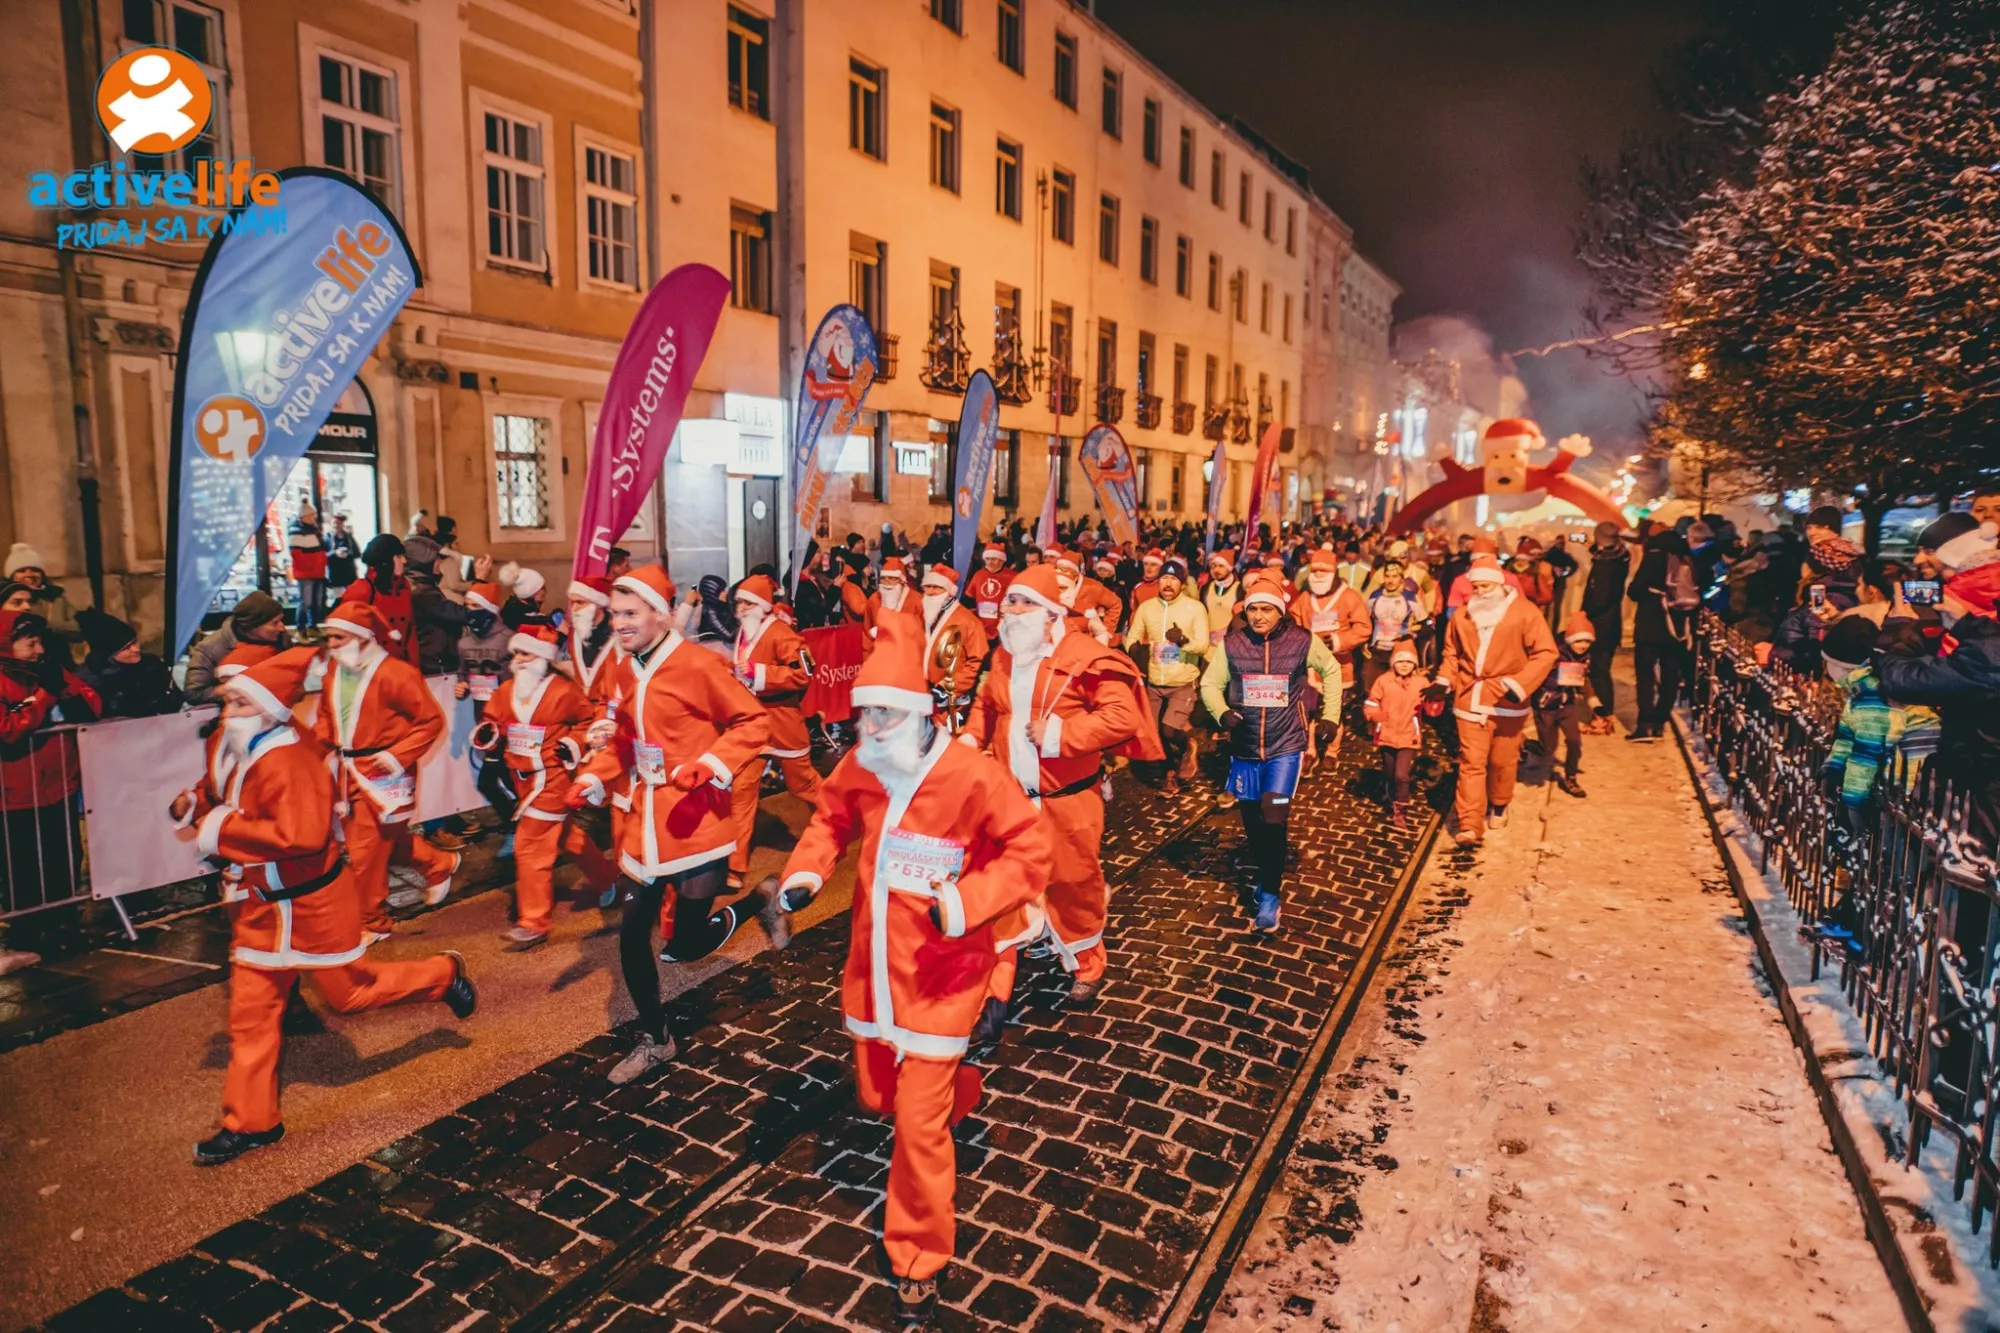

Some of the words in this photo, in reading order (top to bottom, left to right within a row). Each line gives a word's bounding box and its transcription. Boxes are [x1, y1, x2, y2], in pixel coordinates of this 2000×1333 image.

[243, 221, 392, 405] activelife
[274, 360, 335, 436] PRIDAJ
[327, 334, 360, 365] SA
[349, 311, 371, 334] K
[361, 264, 409, 317] NÁM!
[902, 863, 937, 881] 632
